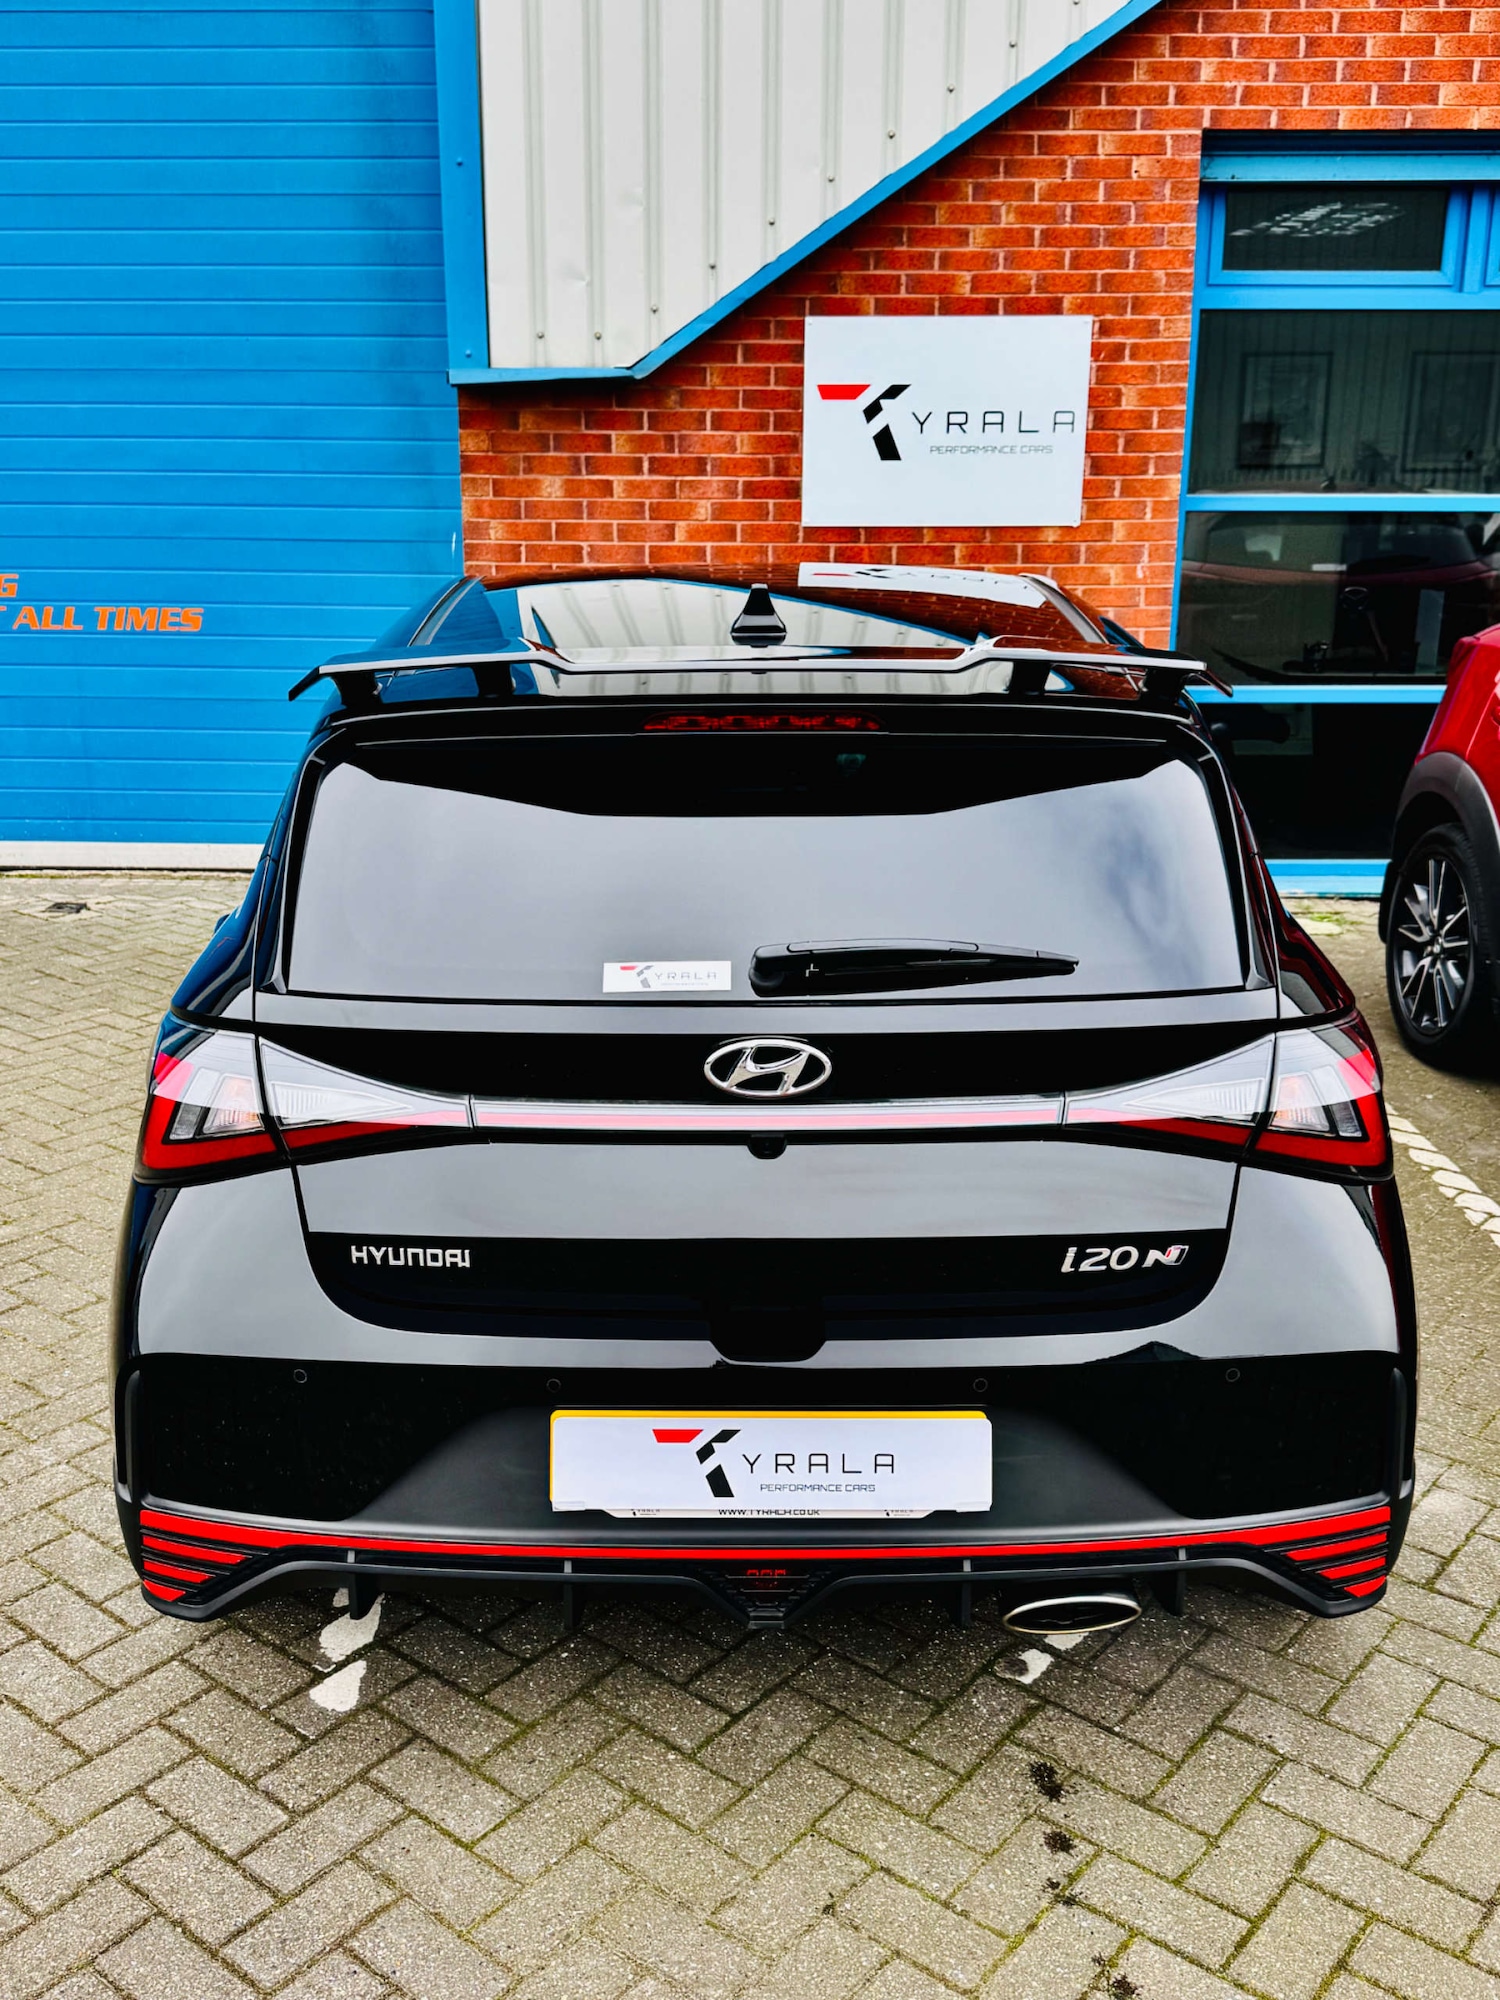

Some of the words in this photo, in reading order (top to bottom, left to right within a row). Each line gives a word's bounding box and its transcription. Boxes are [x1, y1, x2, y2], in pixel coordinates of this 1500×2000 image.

[929, 445, 1017, 455] PERFORMANCE
[1020, 445, 1054, 454] CARS
[12, 606, 84, 630] ALL
[94, 606, 204, 632] TIMES
[350, 1245, 471, 1268] HYUNDAI
[760, 1483, 843, 1492] PERFORMANCE
[845, 1483, 876, 1492] CARS
